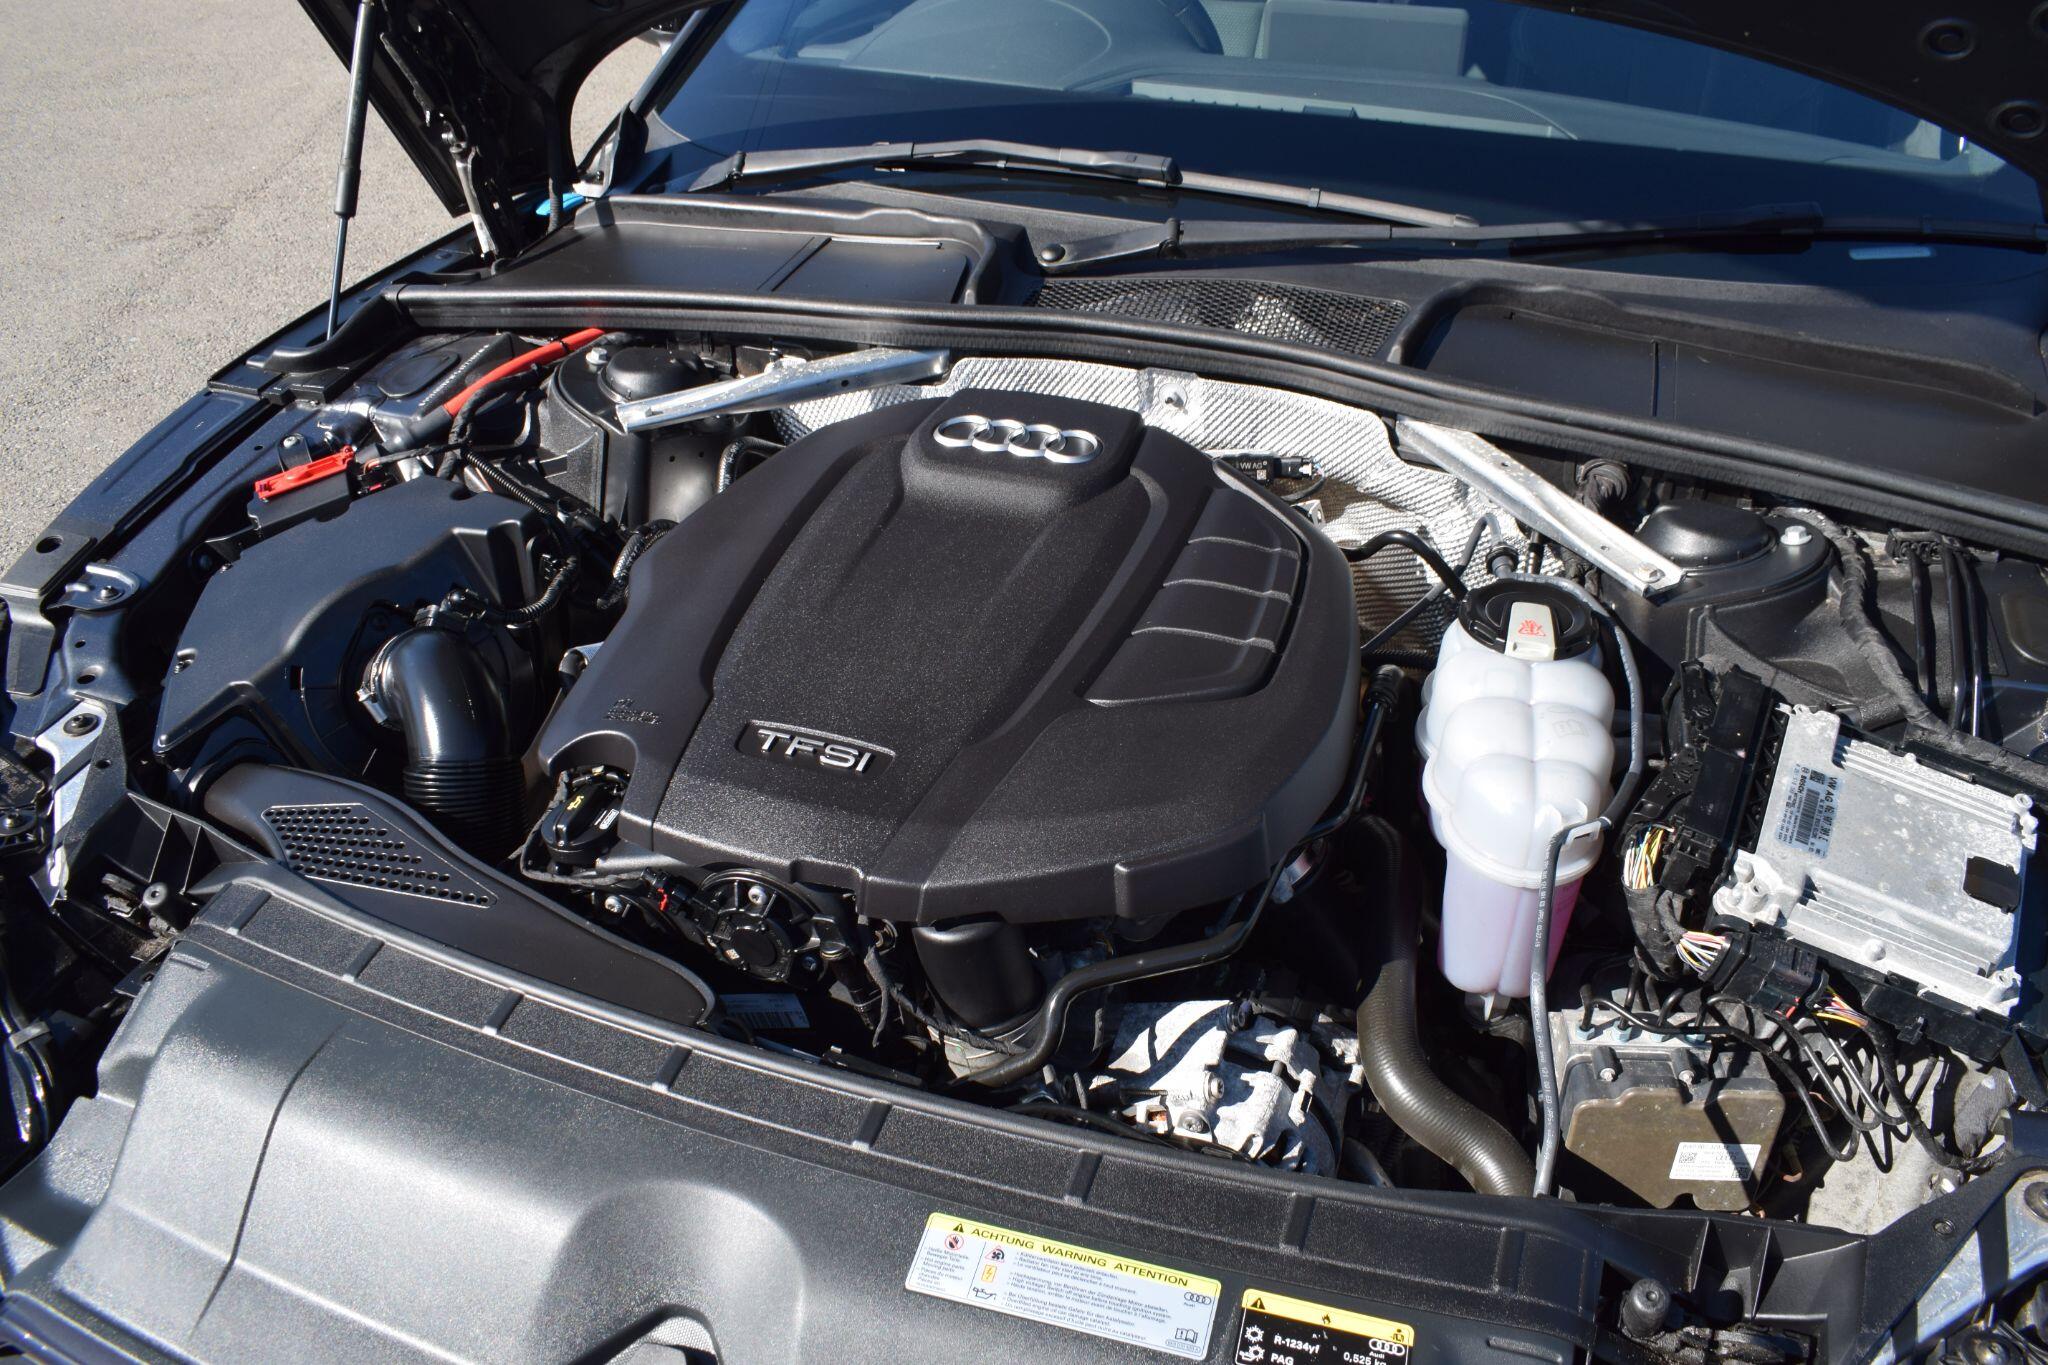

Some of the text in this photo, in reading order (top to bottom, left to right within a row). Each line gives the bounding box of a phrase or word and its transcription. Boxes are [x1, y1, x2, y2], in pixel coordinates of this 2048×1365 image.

[757, 728, 872, 772] TFSI
[1797, 774, 1807, 793] BOSCH
[971, 1227, 1035, 1249] ACHTUNG
[1042, 1244, 1107, 1267] WARNING
[1114, 1262, 1188, 1287] ATTENTION
[1273, 1335, 1320, 1354] R-1234yf
[1270, 1352, 1294, 1365] PAG
[1343, 1351, 1372, 1364] 0,525
[1369, 1351, 1385, 1360] Audi
